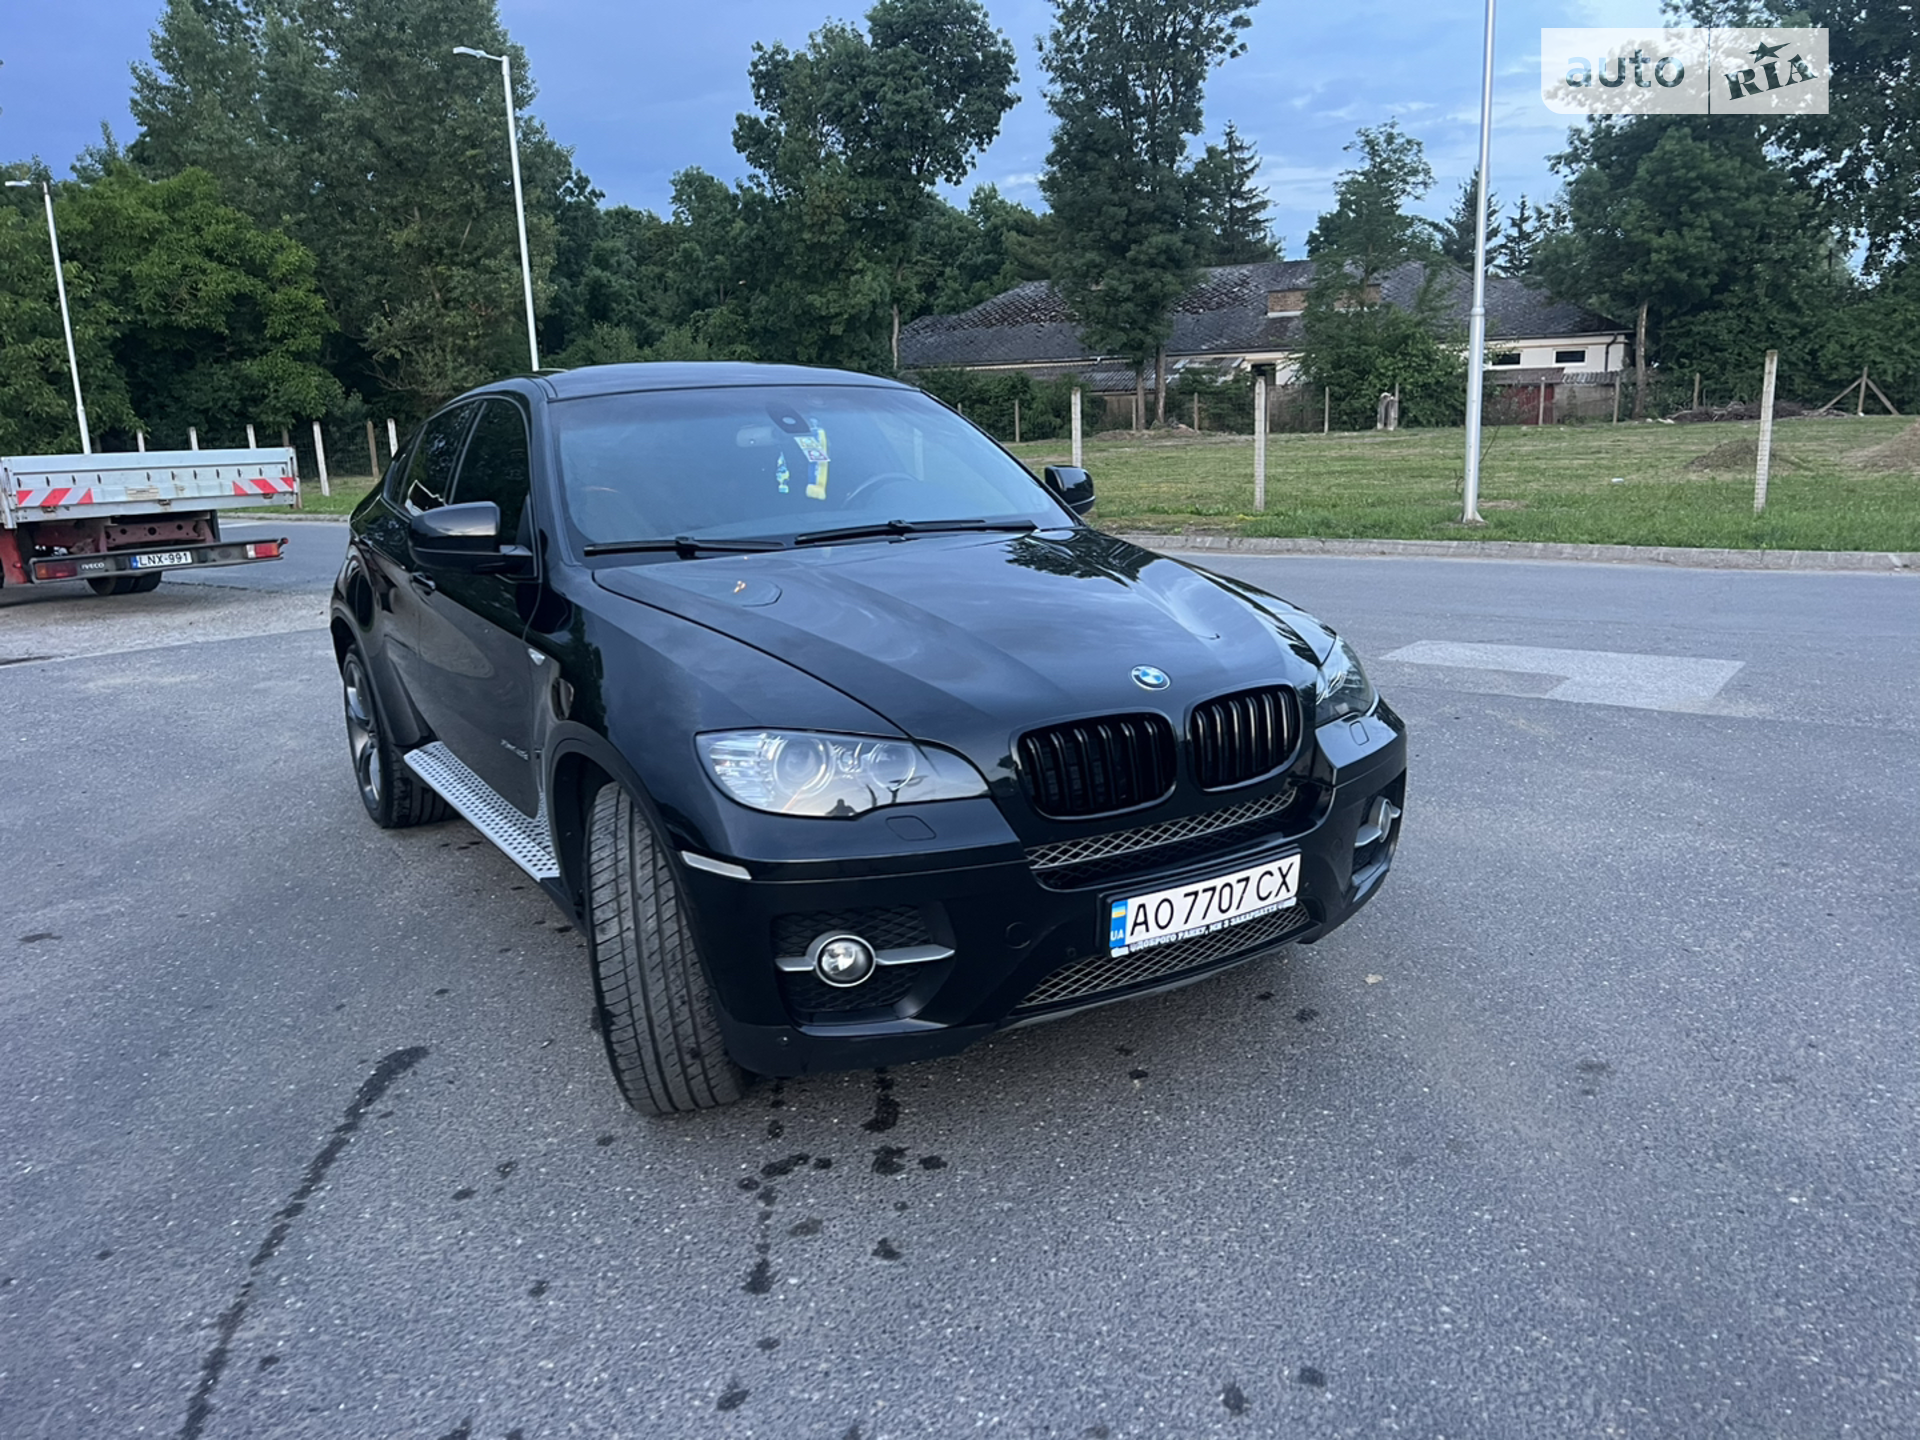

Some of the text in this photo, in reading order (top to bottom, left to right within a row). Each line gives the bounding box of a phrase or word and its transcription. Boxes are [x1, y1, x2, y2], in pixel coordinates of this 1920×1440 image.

[139, 552, 190, 566] LNX-991
[81, 562, 105, 570] IVECO
[1130, 862, 1294, 936] AO 7707 CX
[1110, 929, 1125, 941] UA
